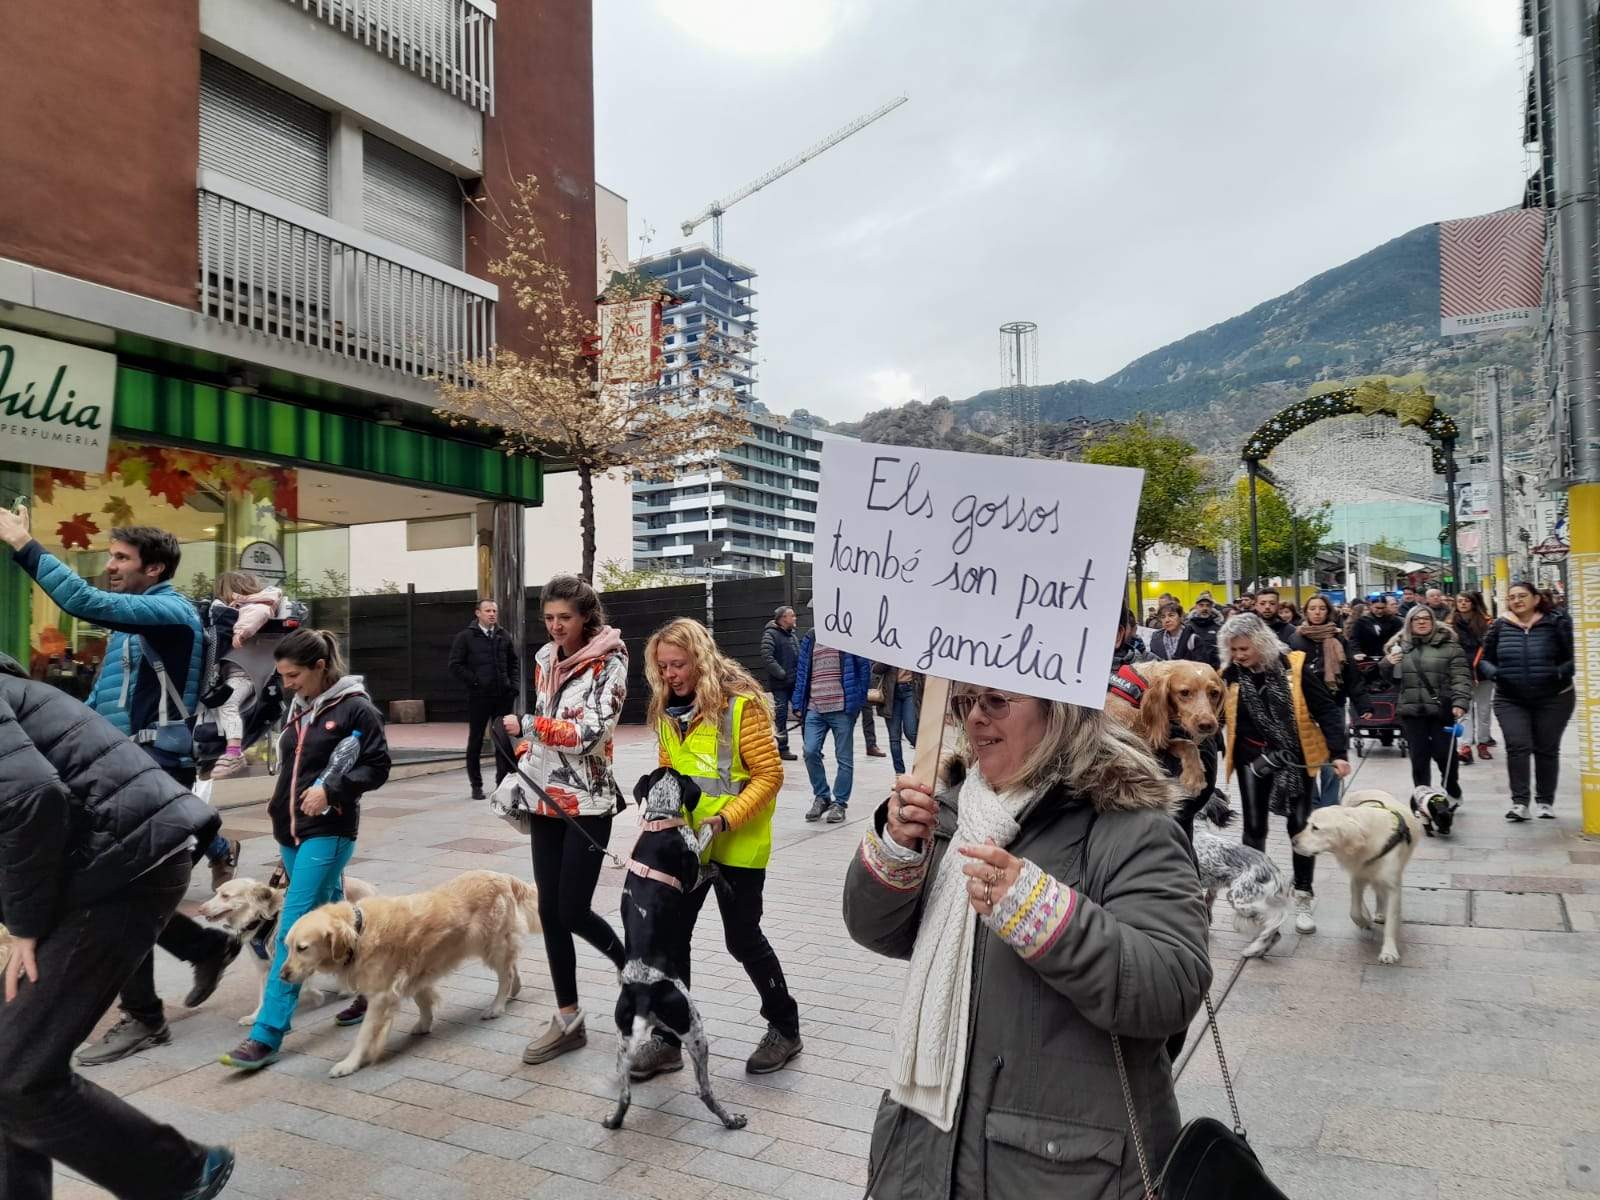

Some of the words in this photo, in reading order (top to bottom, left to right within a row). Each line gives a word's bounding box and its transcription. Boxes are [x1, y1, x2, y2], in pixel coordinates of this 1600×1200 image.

[0, 423, 99, 447] PERFUMERIA
[867, 457, 933, 518] Els
[952, 494, 1059, 555] gossos
[830, 519, 922, 583] també
[932, 562, 996, 595] son
[1016, 559, 1095, 619] part
[824, 587, 853, 637] de
[871, 595, 902, 649] la
[916, 624, 1088, 685] família!
